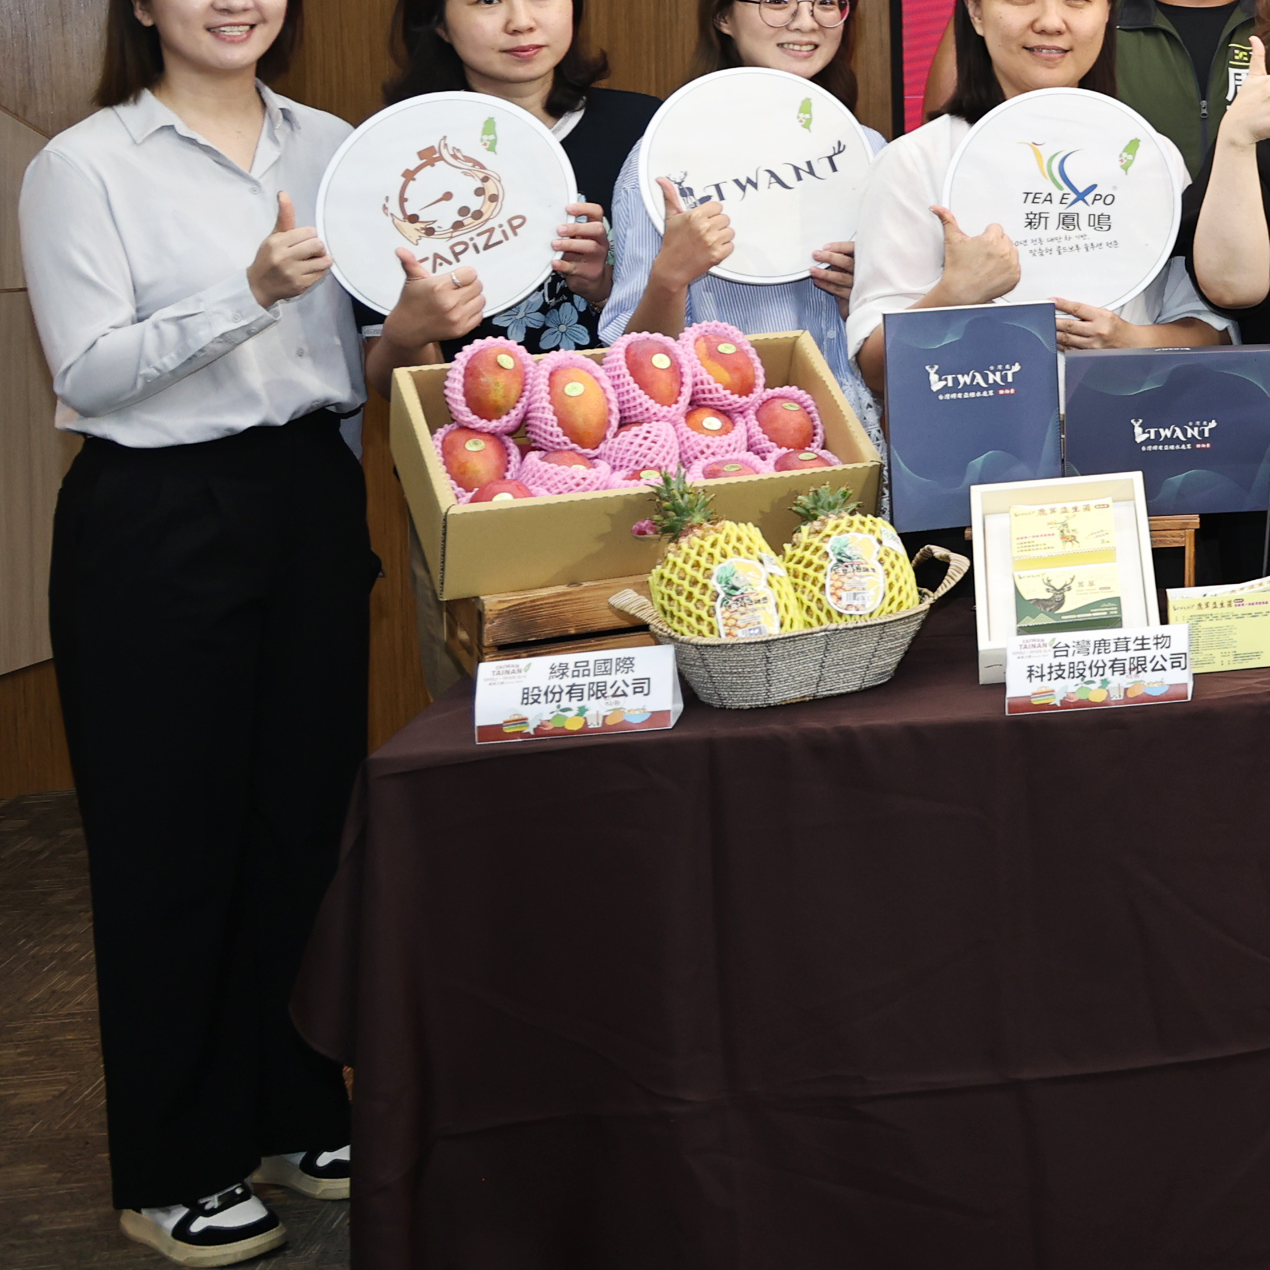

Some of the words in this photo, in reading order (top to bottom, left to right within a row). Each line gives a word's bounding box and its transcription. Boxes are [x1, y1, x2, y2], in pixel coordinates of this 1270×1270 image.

[1022, 191, 1053, 205] TEA
[1059, 184, 1116, 210] EXPO
[1024, 211, 1112, 232] 新鳳鳴
[1052, 634, 1171, 659] 台灣鹿茸生物
[548, 656, 635, 680] 綠品國際
[1026, 652, 1188, 683] 科技股份有限公司
[521, 677, 652, 706] 股份有限公司
